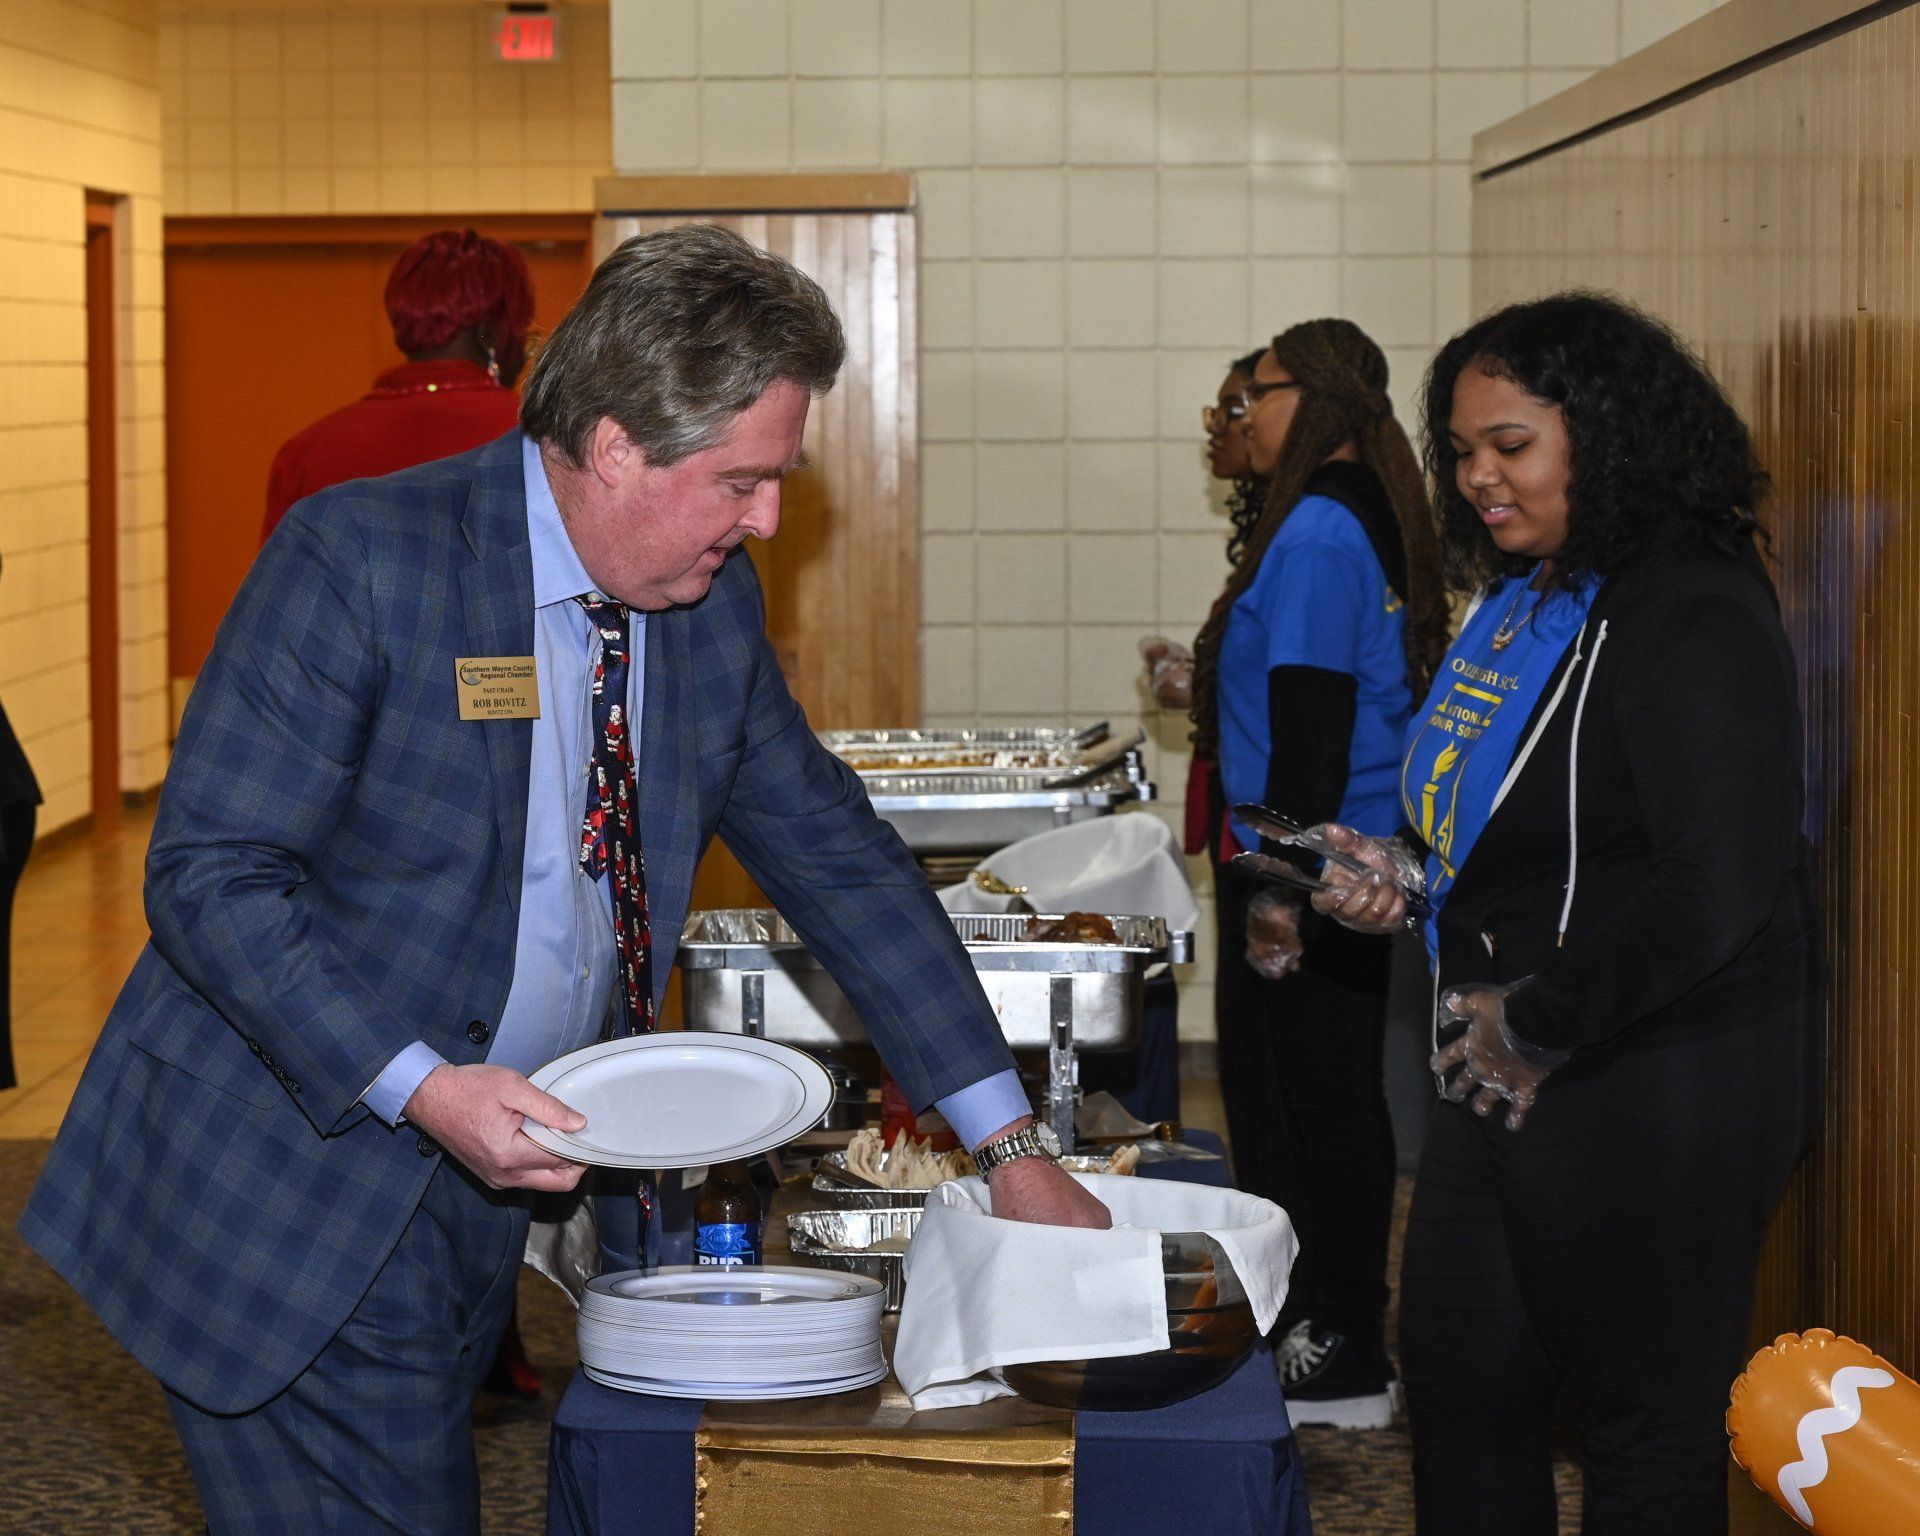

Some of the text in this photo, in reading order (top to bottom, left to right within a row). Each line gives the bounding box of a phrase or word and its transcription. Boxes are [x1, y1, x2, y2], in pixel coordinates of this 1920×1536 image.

[502, 17, 553, 60] EXIT
[473, 697, 527, 708] ROB BOVITZ
